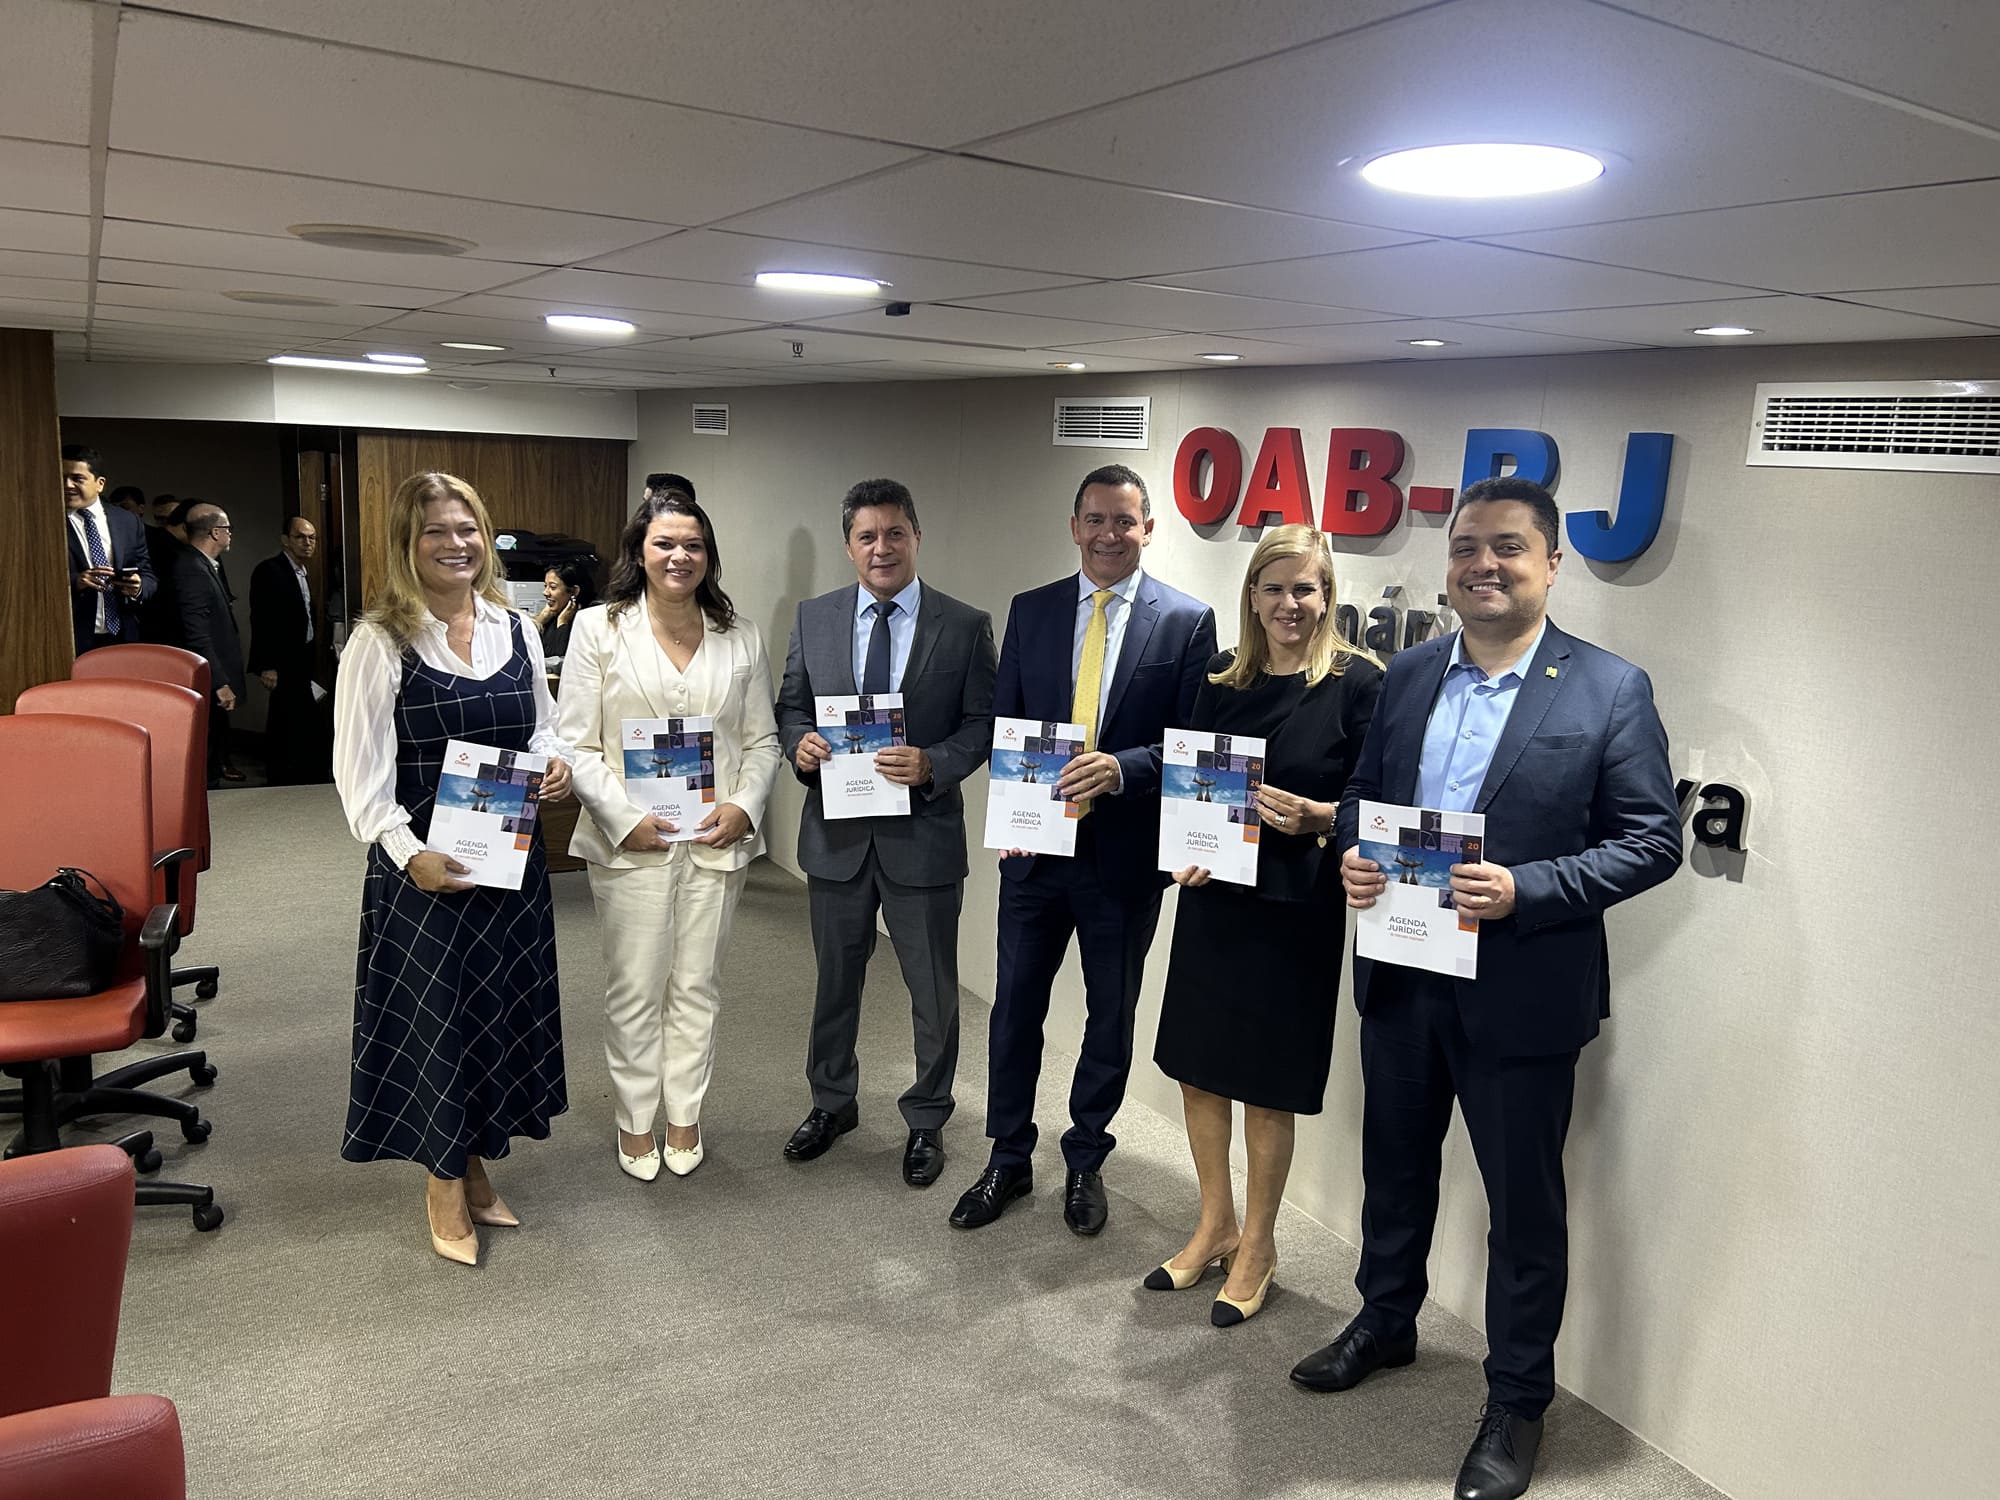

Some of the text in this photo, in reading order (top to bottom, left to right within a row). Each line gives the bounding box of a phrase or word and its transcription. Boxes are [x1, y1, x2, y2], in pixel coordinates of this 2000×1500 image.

[1251, 762, 1261, 770] 20
[846, 784, 875, 793] JURÍDICA
[1011, 810, 1041, 819] AGENDA
[1010, 817, 1042, 826] JURÍDICA
[1187, 831, 1218, 841] AGENDA
[455, 839, 488, 849] AGENDA
[1185, 838, 1219, 849] JURÍDICA
[1467, 842, 1479, 850] 20
[453, 846, 488, 857] JURÍDICA
[1389, 915, 1427, 929] AGENDA
[1387, 923, 1428, 937] JURÍDICA
